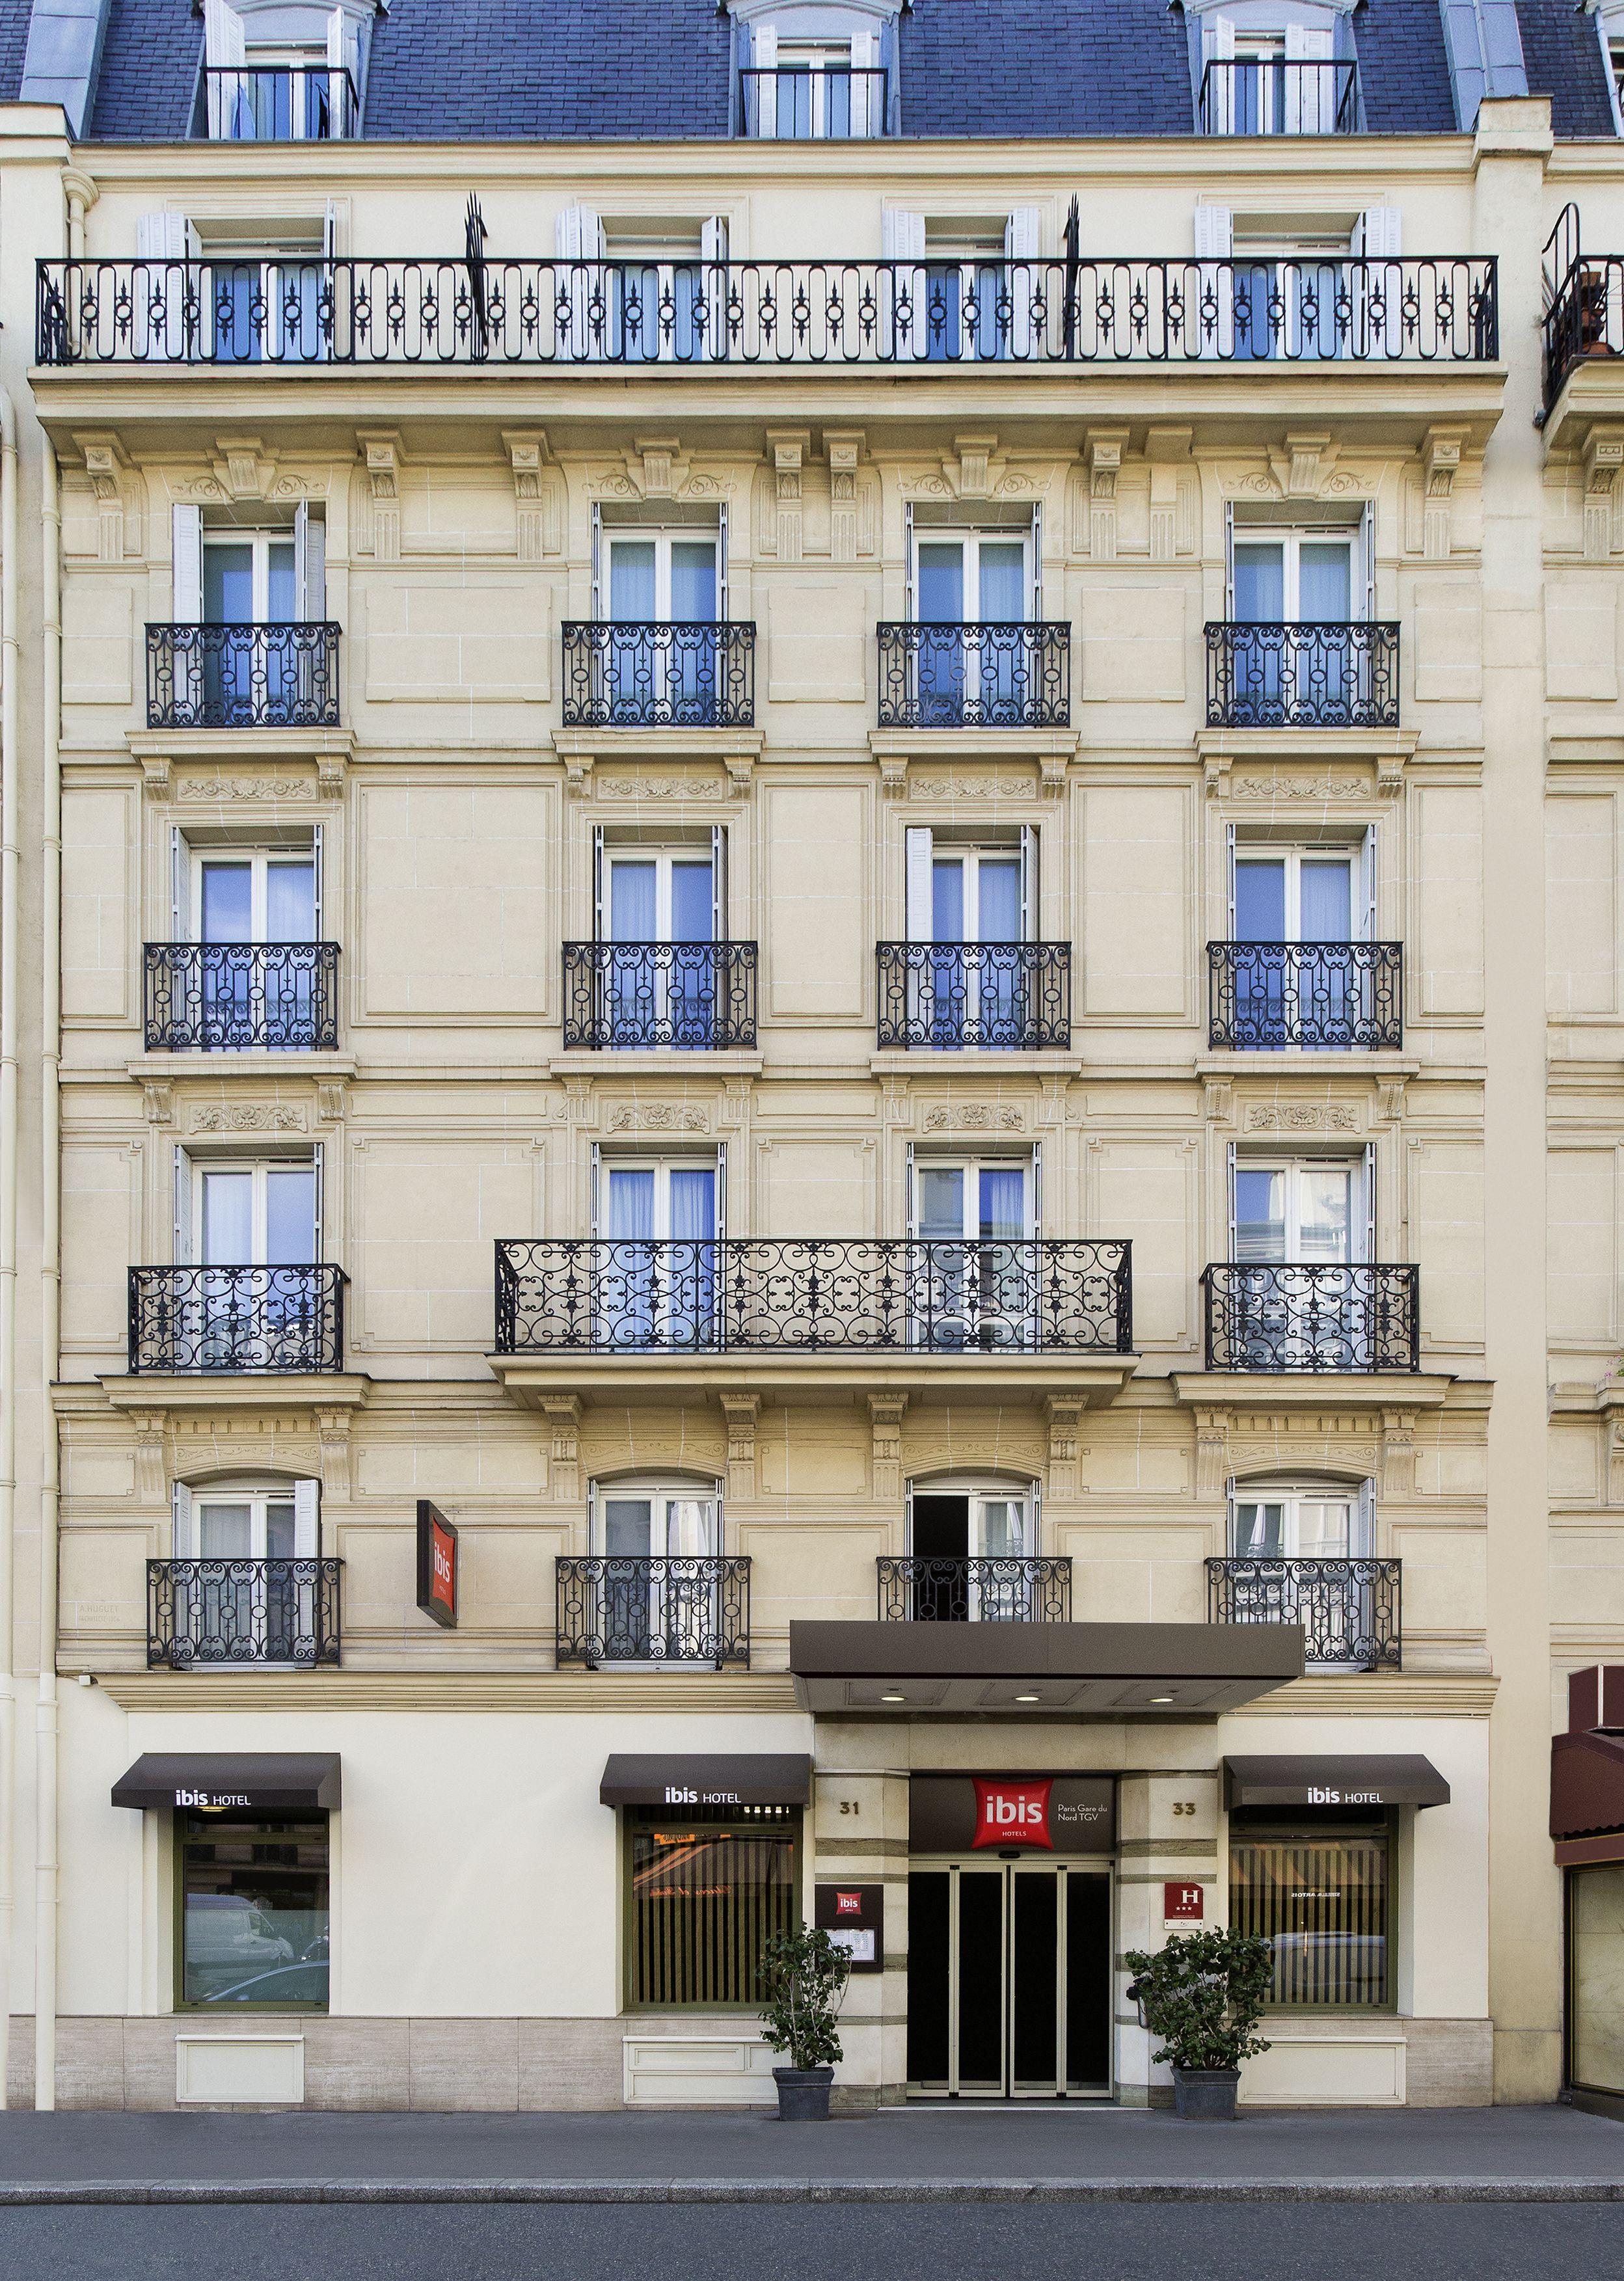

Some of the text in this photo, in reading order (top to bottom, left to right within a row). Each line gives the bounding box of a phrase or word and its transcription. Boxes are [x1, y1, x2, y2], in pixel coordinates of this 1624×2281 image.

[435, 1541, 450, 1583] ibis
[176, 1789, 252, 1805] ibis HOTEL
[665, 1787, 742, 1803] ibis HOTEL
[1308, 1787, 1384, 1803] ibis HOTEL
[840, 1802, 859, 1815] 31
[986, 1796, 1042, 1824] ibis
[1173, 1802, 1196, 1815] 33
[840, 1898, 858, 1908] ibis
[1181, 1890, 1200, 1904] H
